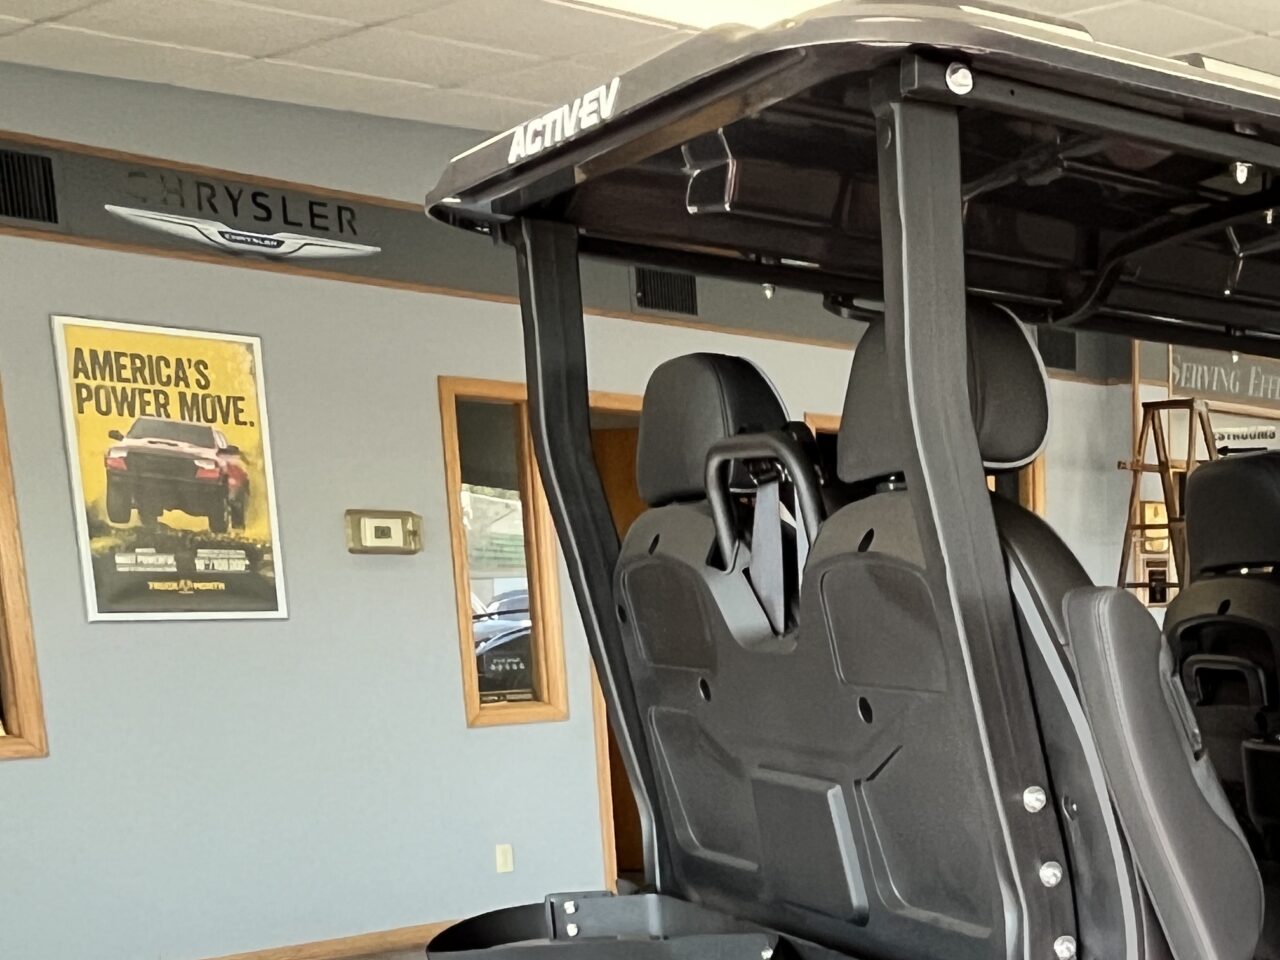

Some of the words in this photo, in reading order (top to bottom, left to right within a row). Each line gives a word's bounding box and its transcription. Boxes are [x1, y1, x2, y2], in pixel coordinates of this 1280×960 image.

[127, 171, 358, 236] CHRYSLER
[73, 347, 211, 390] AMERICA'S
[1173, 354, 1240, 393] SERVING
[75, 383, 171, 419] POWER
[178, 391, 255, 427] MOVE.
